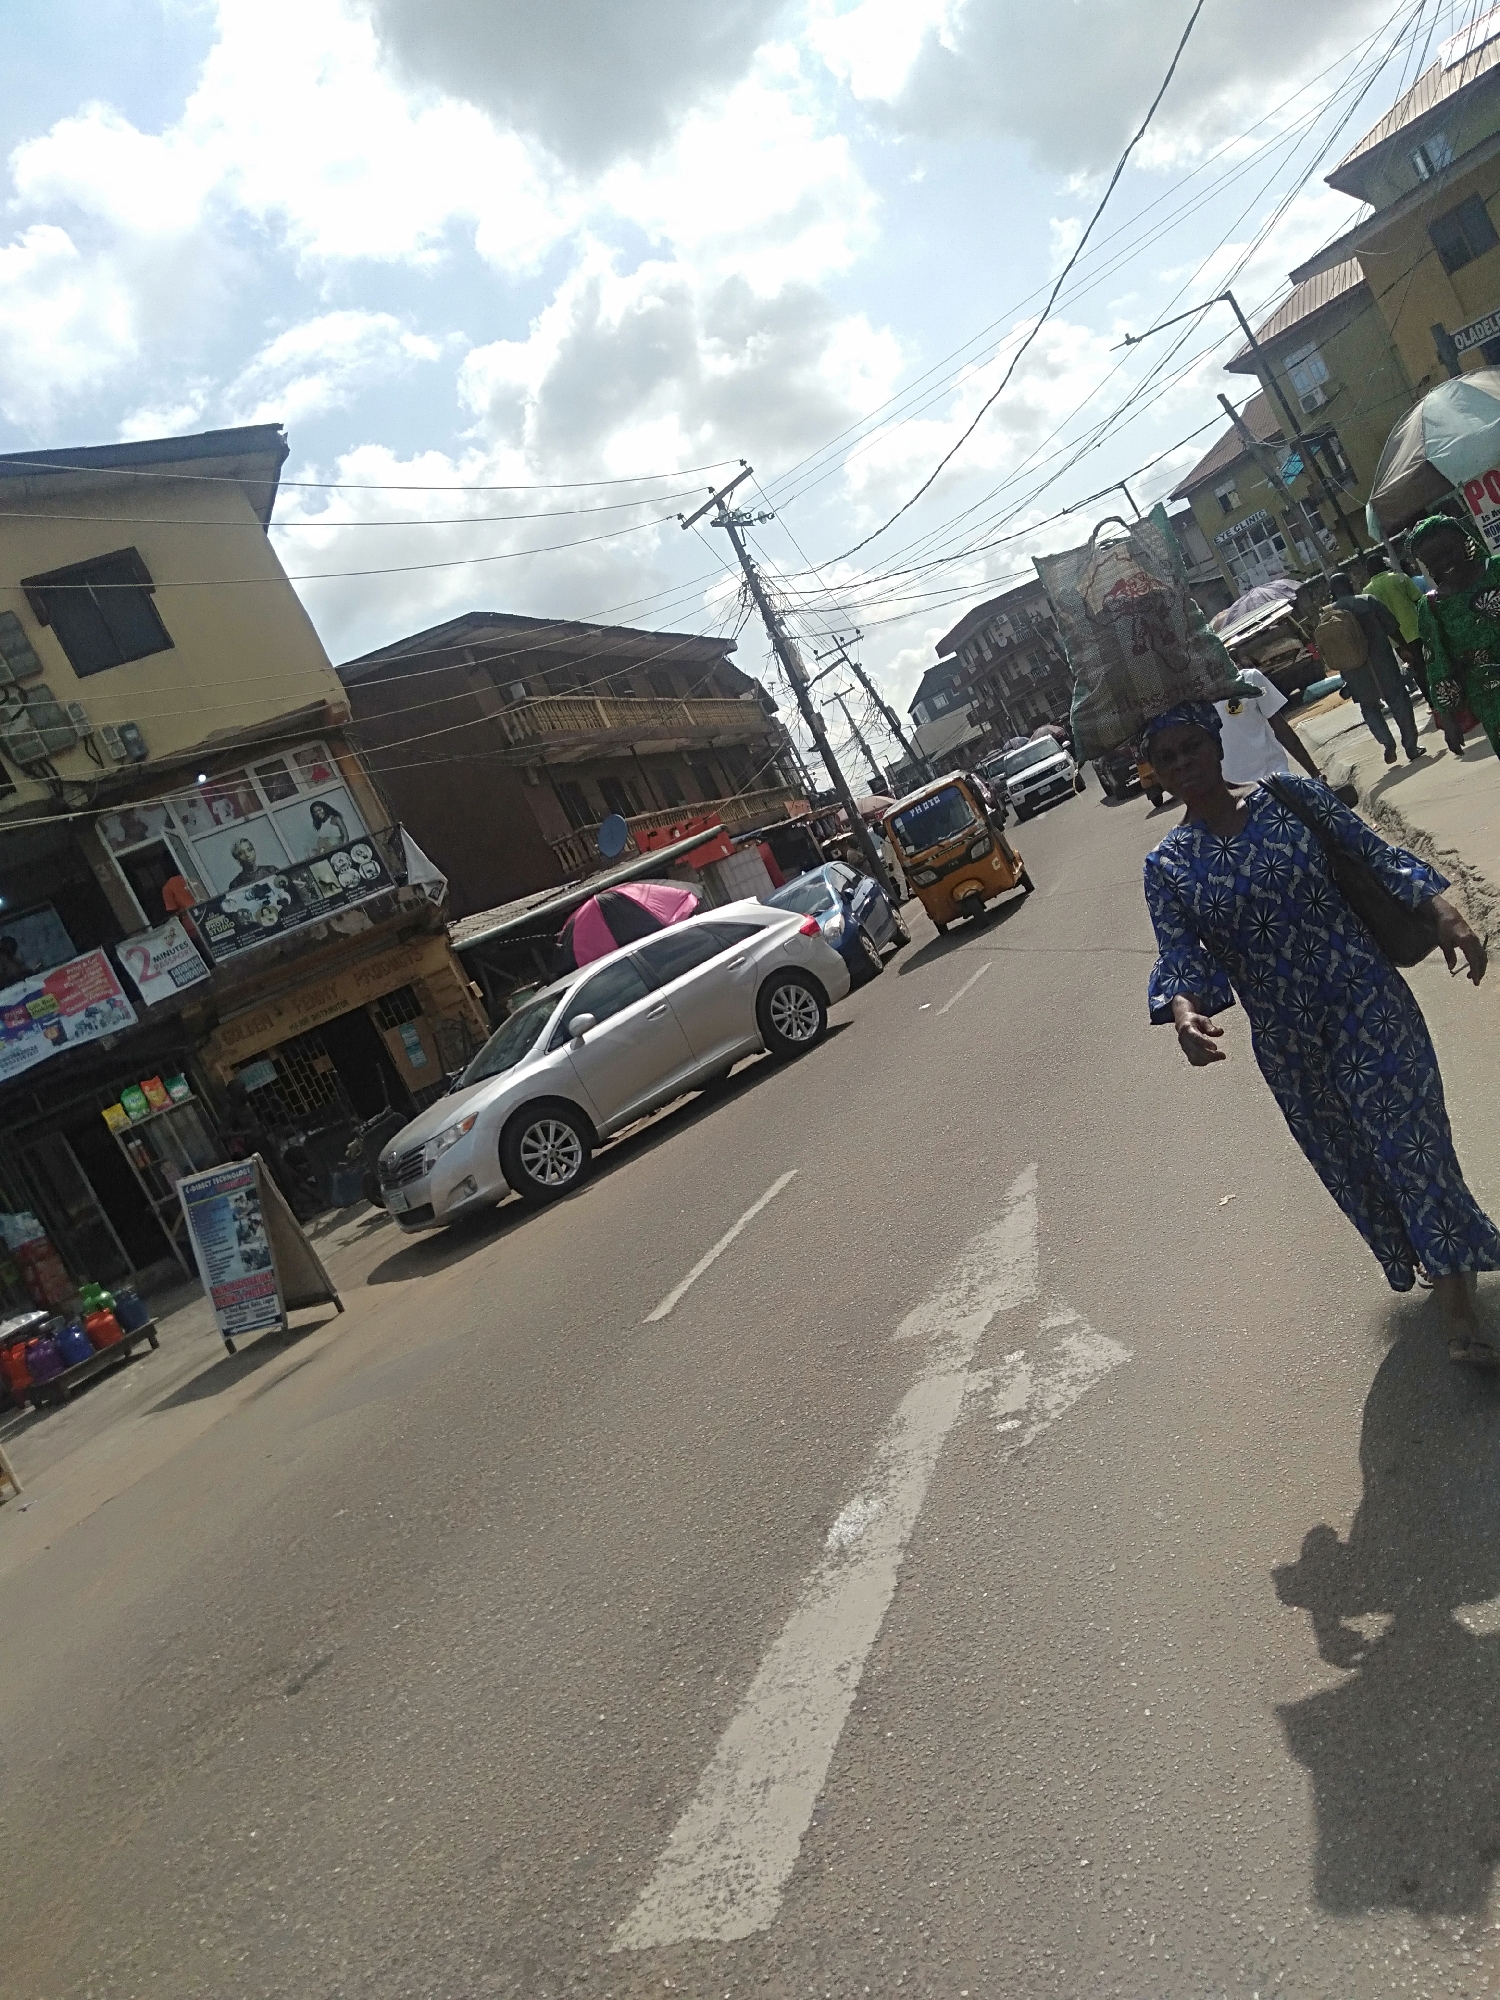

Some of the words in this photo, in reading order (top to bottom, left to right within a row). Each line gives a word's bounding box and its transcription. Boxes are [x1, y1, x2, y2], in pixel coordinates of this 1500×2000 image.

[1214, 532, 1233, 545] EYE
[1233, 509, 1267, 532] CLINIC
[205, 917, 230, 932] PHOTO
[209, 921, 236, 936] STUDIO
[152, 940, 189, 962] MINUTES
[153, 946, 195, 970] PASSPORT
[125, 945, 162, 983] 2
[353, 950, 424, 987] PRODUCTS
[213, 1167, 252, 1186] TECHNOLOGY
